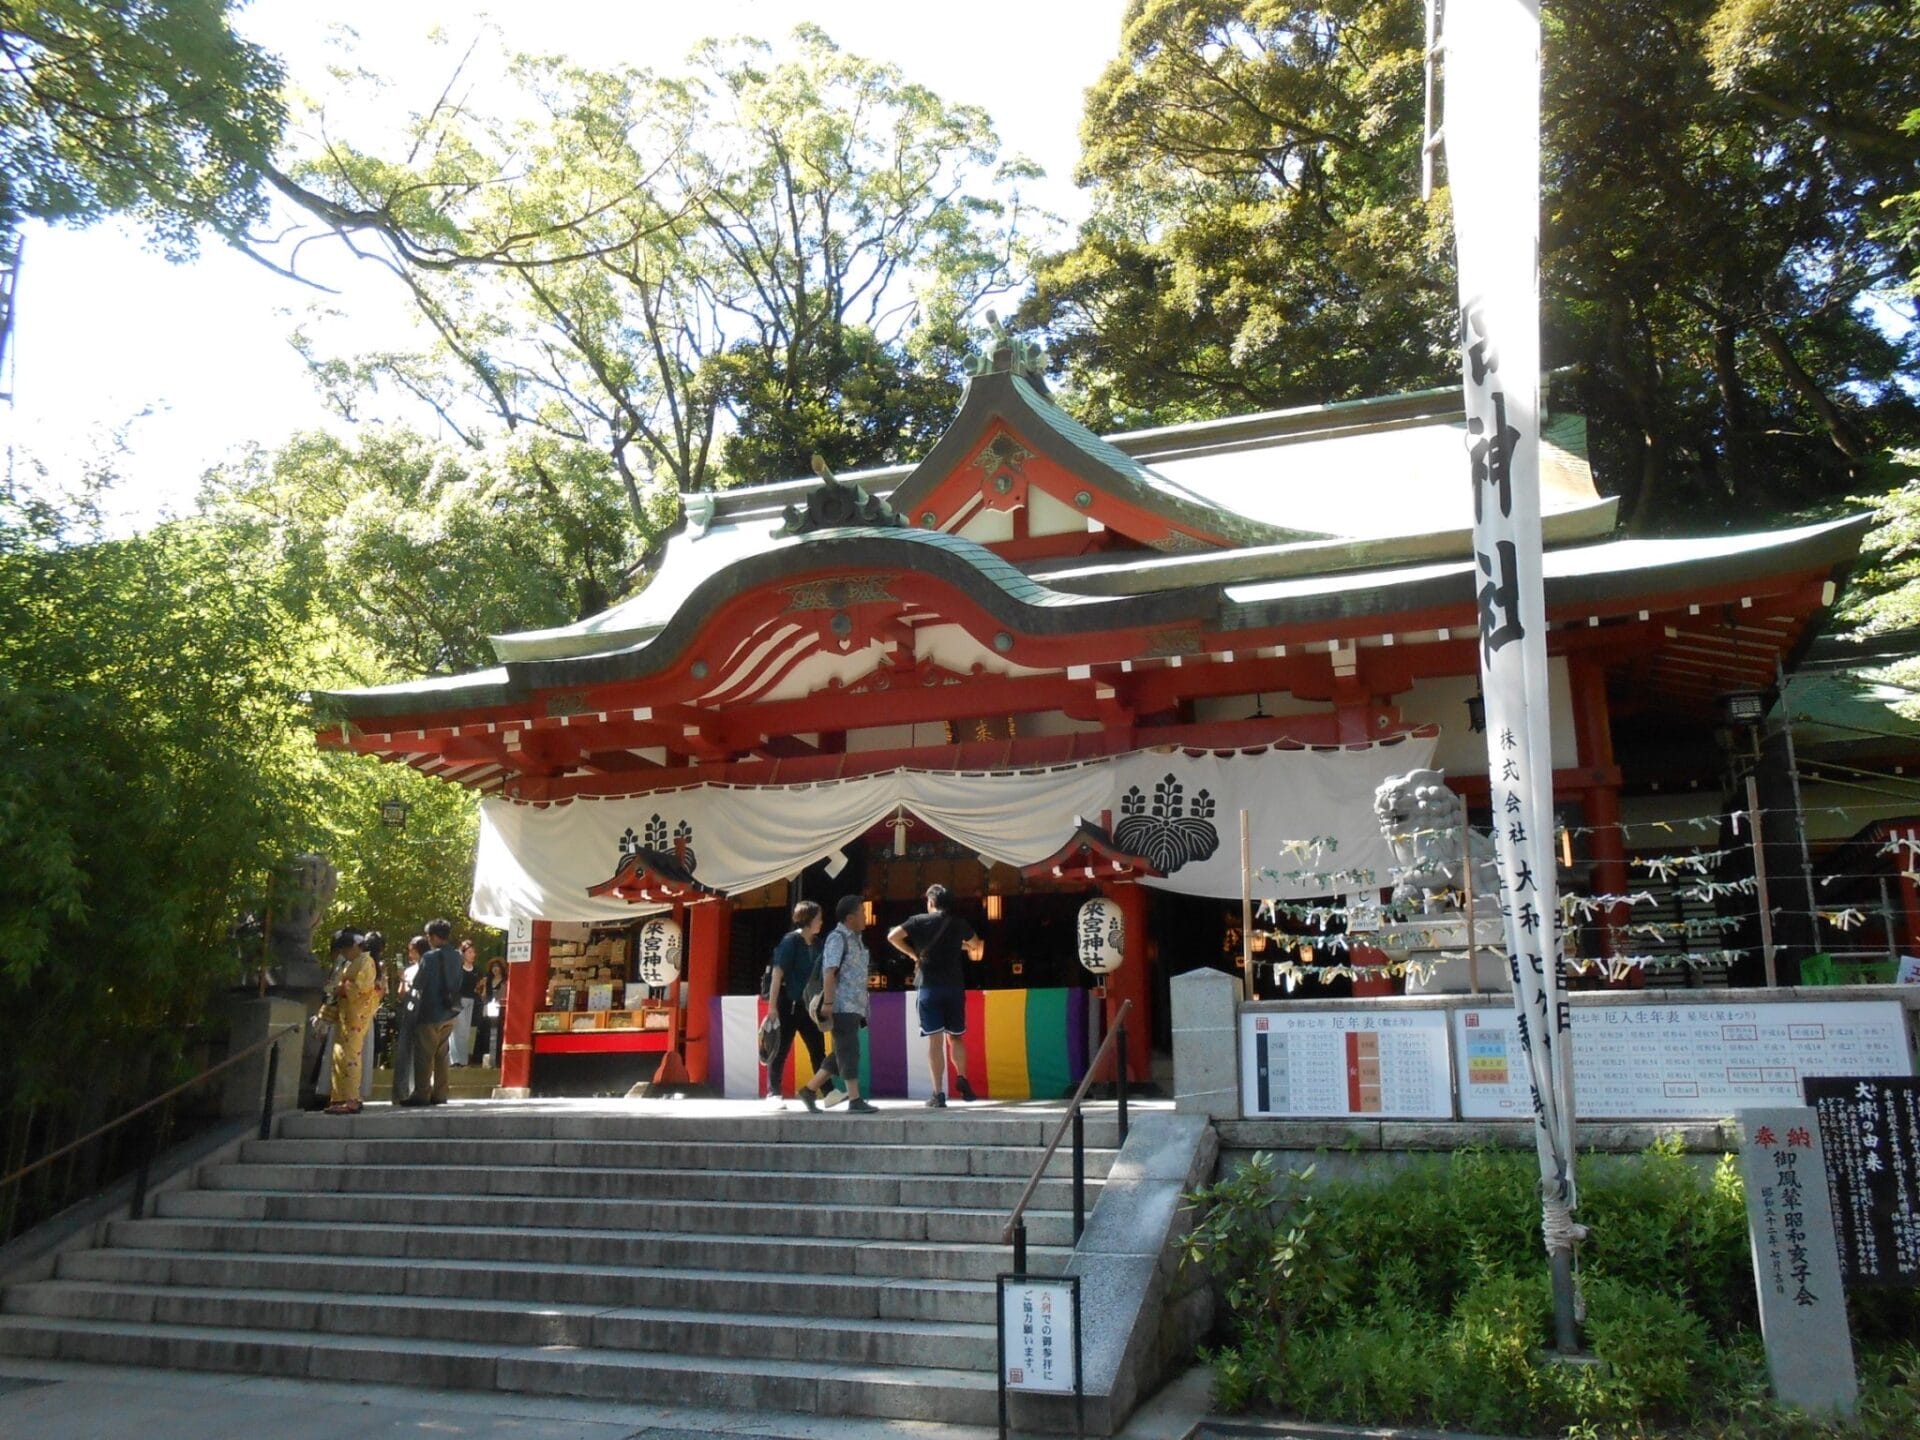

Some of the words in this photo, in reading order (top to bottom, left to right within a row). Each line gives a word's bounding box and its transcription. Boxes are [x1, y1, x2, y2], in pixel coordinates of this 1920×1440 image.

[1571, 1013, 1600, 1023] 和七年
[1754, 1125, 1813, 1149] 奉納
